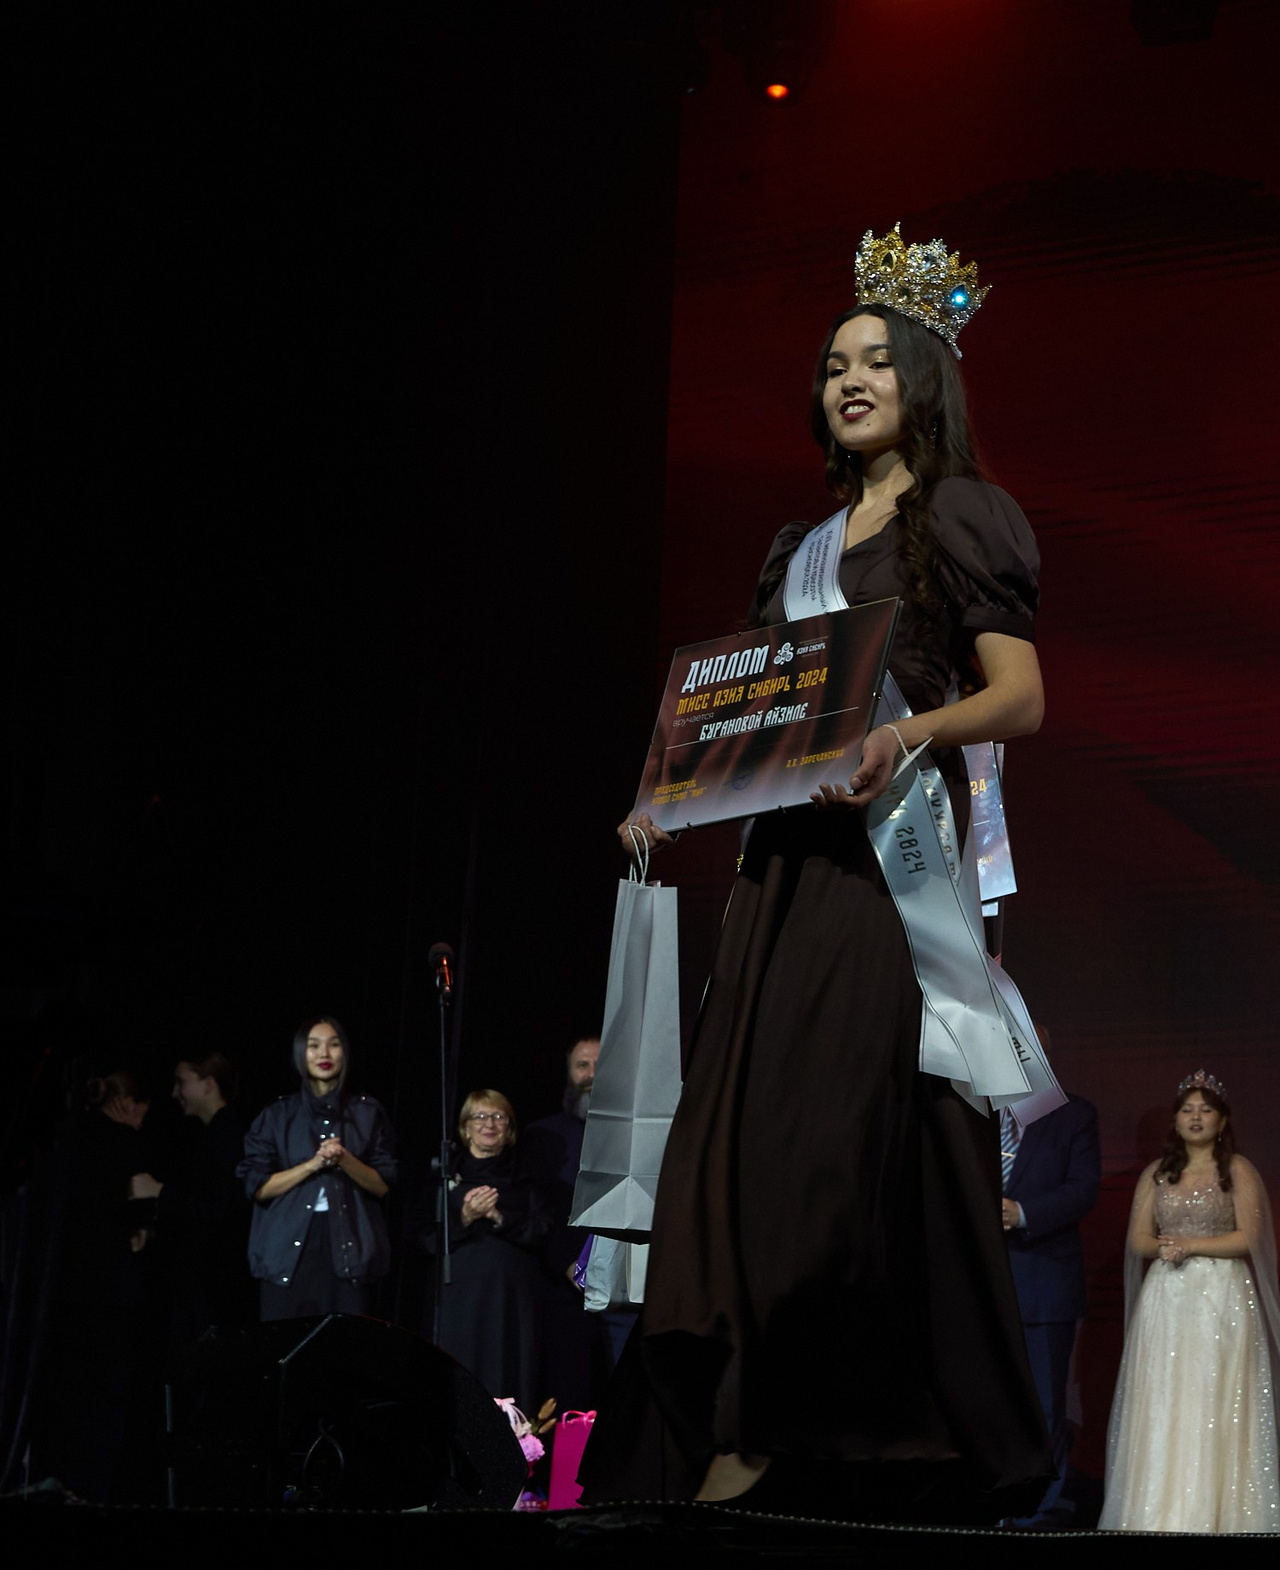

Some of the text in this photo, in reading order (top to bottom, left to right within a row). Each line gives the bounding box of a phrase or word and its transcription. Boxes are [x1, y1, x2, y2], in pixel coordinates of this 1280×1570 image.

[676, 667, 829, 716] МИСС АЗИЯ СИБИРЬ 2024
[681, 645, 770, 693] ДИПЛОМ
[672, 712, 715, 728] вручается
[699, 702, 809, 741] БУРАНОВОЙ АЙЗИЛЕ
[895, 826, 927, 875] 2024
